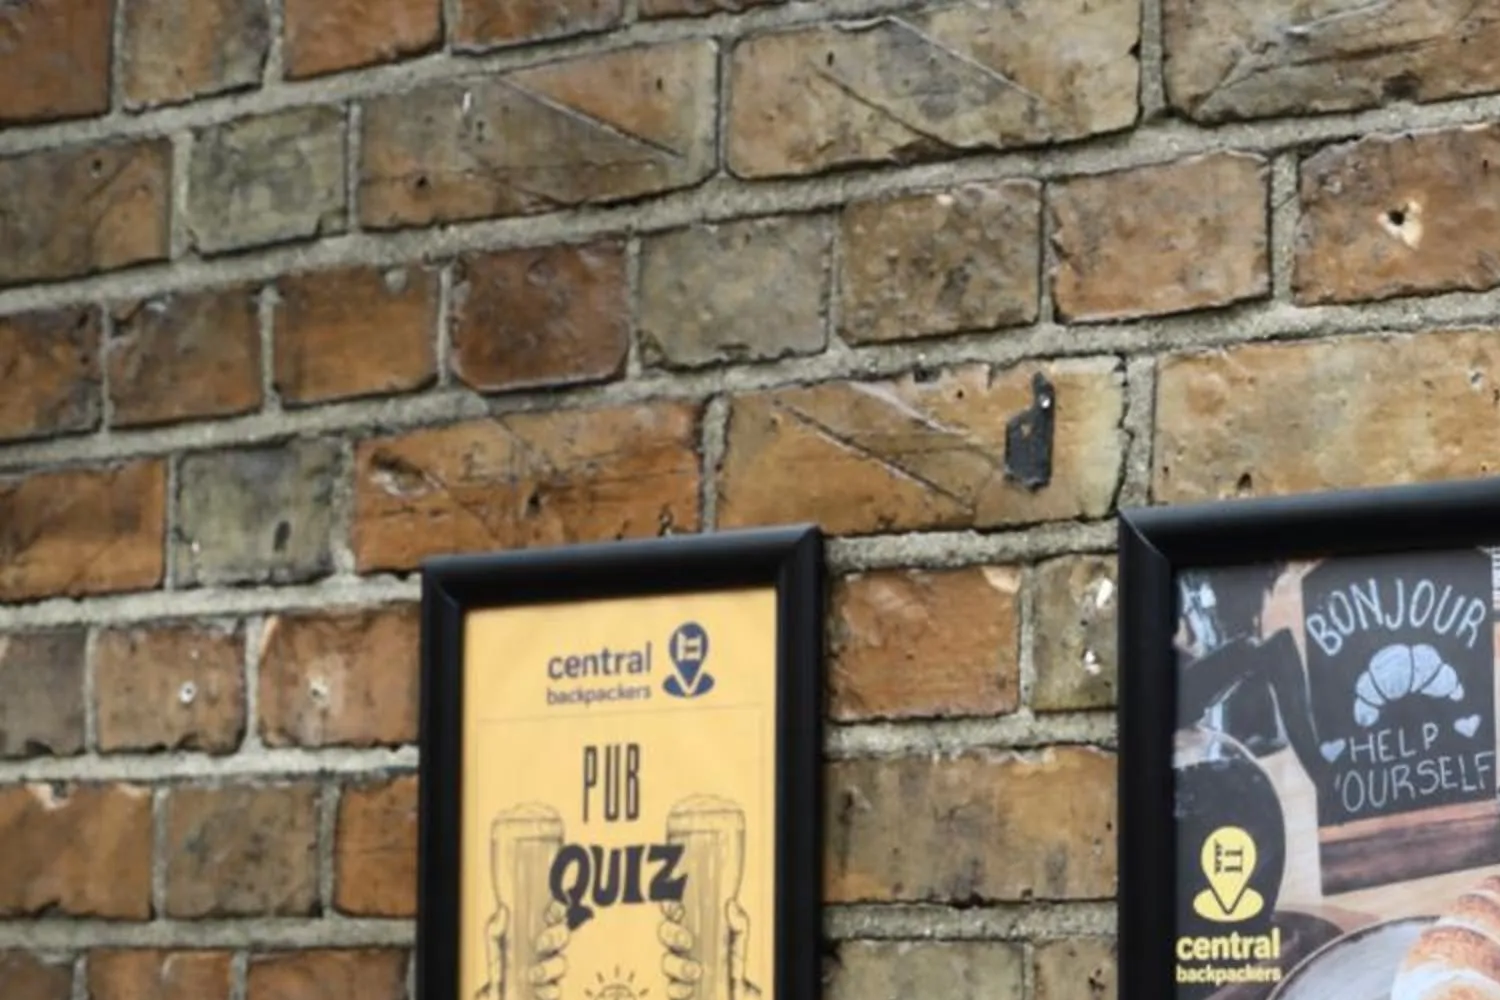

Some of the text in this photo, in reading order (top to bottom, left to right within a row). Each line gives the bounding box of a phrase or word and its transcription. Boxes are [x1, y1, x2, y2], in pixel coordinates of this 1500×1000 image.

[1306, 579, 1486, 656] BONJOUR
[547, 641, 652, 680] central
[546, 683, 652, 707] backpackers
[1349, 722, 1439, 764] HELP
[583, 743, 640, 823] PUB
[1334, 750, 1494, 813] OURSELF
[549, 843, 688, 930] QUIZ
[1176, 928, 1280, 960] central
[1176, 963, 1281, 986] backpackers
